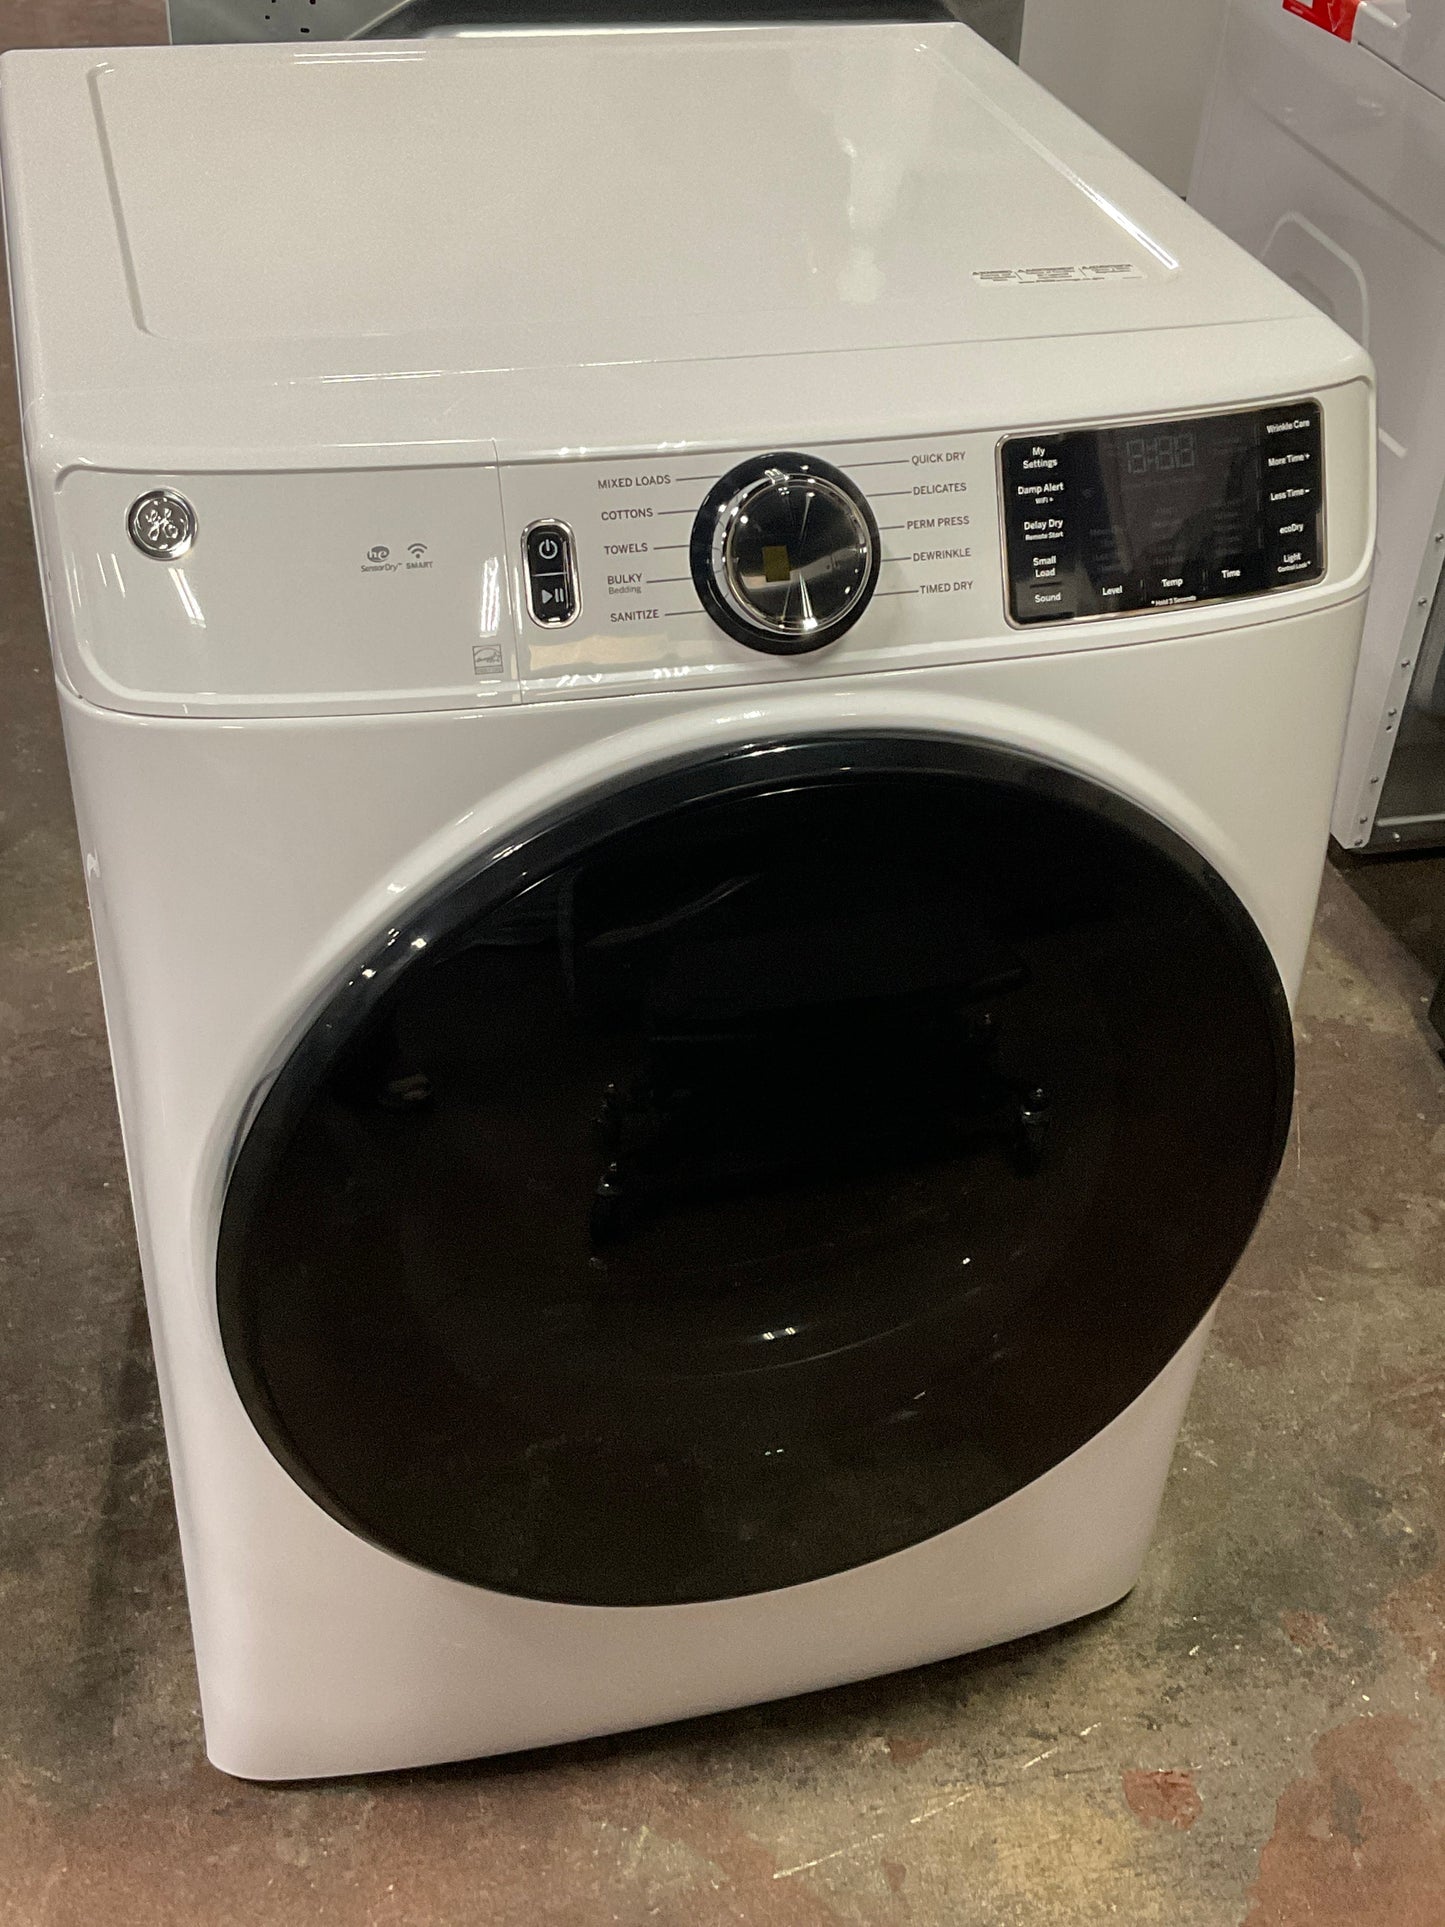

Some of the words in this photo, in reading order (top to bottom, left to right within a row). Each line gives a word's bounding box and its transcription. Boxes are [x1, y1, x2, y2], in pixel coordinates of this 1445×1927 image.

[1266, 422, 1292, 434] Wrinkle
[1294, 419, 1310, 429] Care
[1032, 446, 1046, 457] My
[912, 452, 942, 465] QUICK
[945, 452, 966, 462] DRY
[1023, 457, 1058, 469] Settings
[1268, 456, 1286, 467] More
[1287, 455, 1304, 464] Time
[597, 478, 633, 489] MIXED
[636, 475, 671, 486] LOADS
[913, 483, 967, 496] DELICATES
[1018, 484, 1041, 495] Damp
[1043, 482, 1064, 493] Alert
[1270, 491, 1286, 501] Less
[1287, 489, 1304, 498] Time
[601, 508, 653, 521] COTTONS
[907, 518, 936, 529] PERM
[938, 515, 970, 527] PRESS
[1024, 520, 1047, 531] Delay
[1048, 518, 1063, 529] Dry
[1279, 522, 1304, 535] ecoDry
[604, 543, 648, 554] TOWELS
[913, 548, 972, 562] DEWRINKLE
[1033, 555, 1056, 566] Small
[1283, 552, 1301, 563] Light
[1035, 567, 1055, 578] Load
[1222, 568, 1240, 578] Time
[607, 573, 642, 585] BULKY
[1161, 576, 1183, 588] Temp
[608, 584, 641, 595] Bedding
[920, 584, 951, 594] TIMED
[952, 581, 973, 591] DRY
[1102, 585, 1123, 595] Level
[1035, 592, 1061, 602] Sound
[610, 609, 659, 622] SANITIZE
